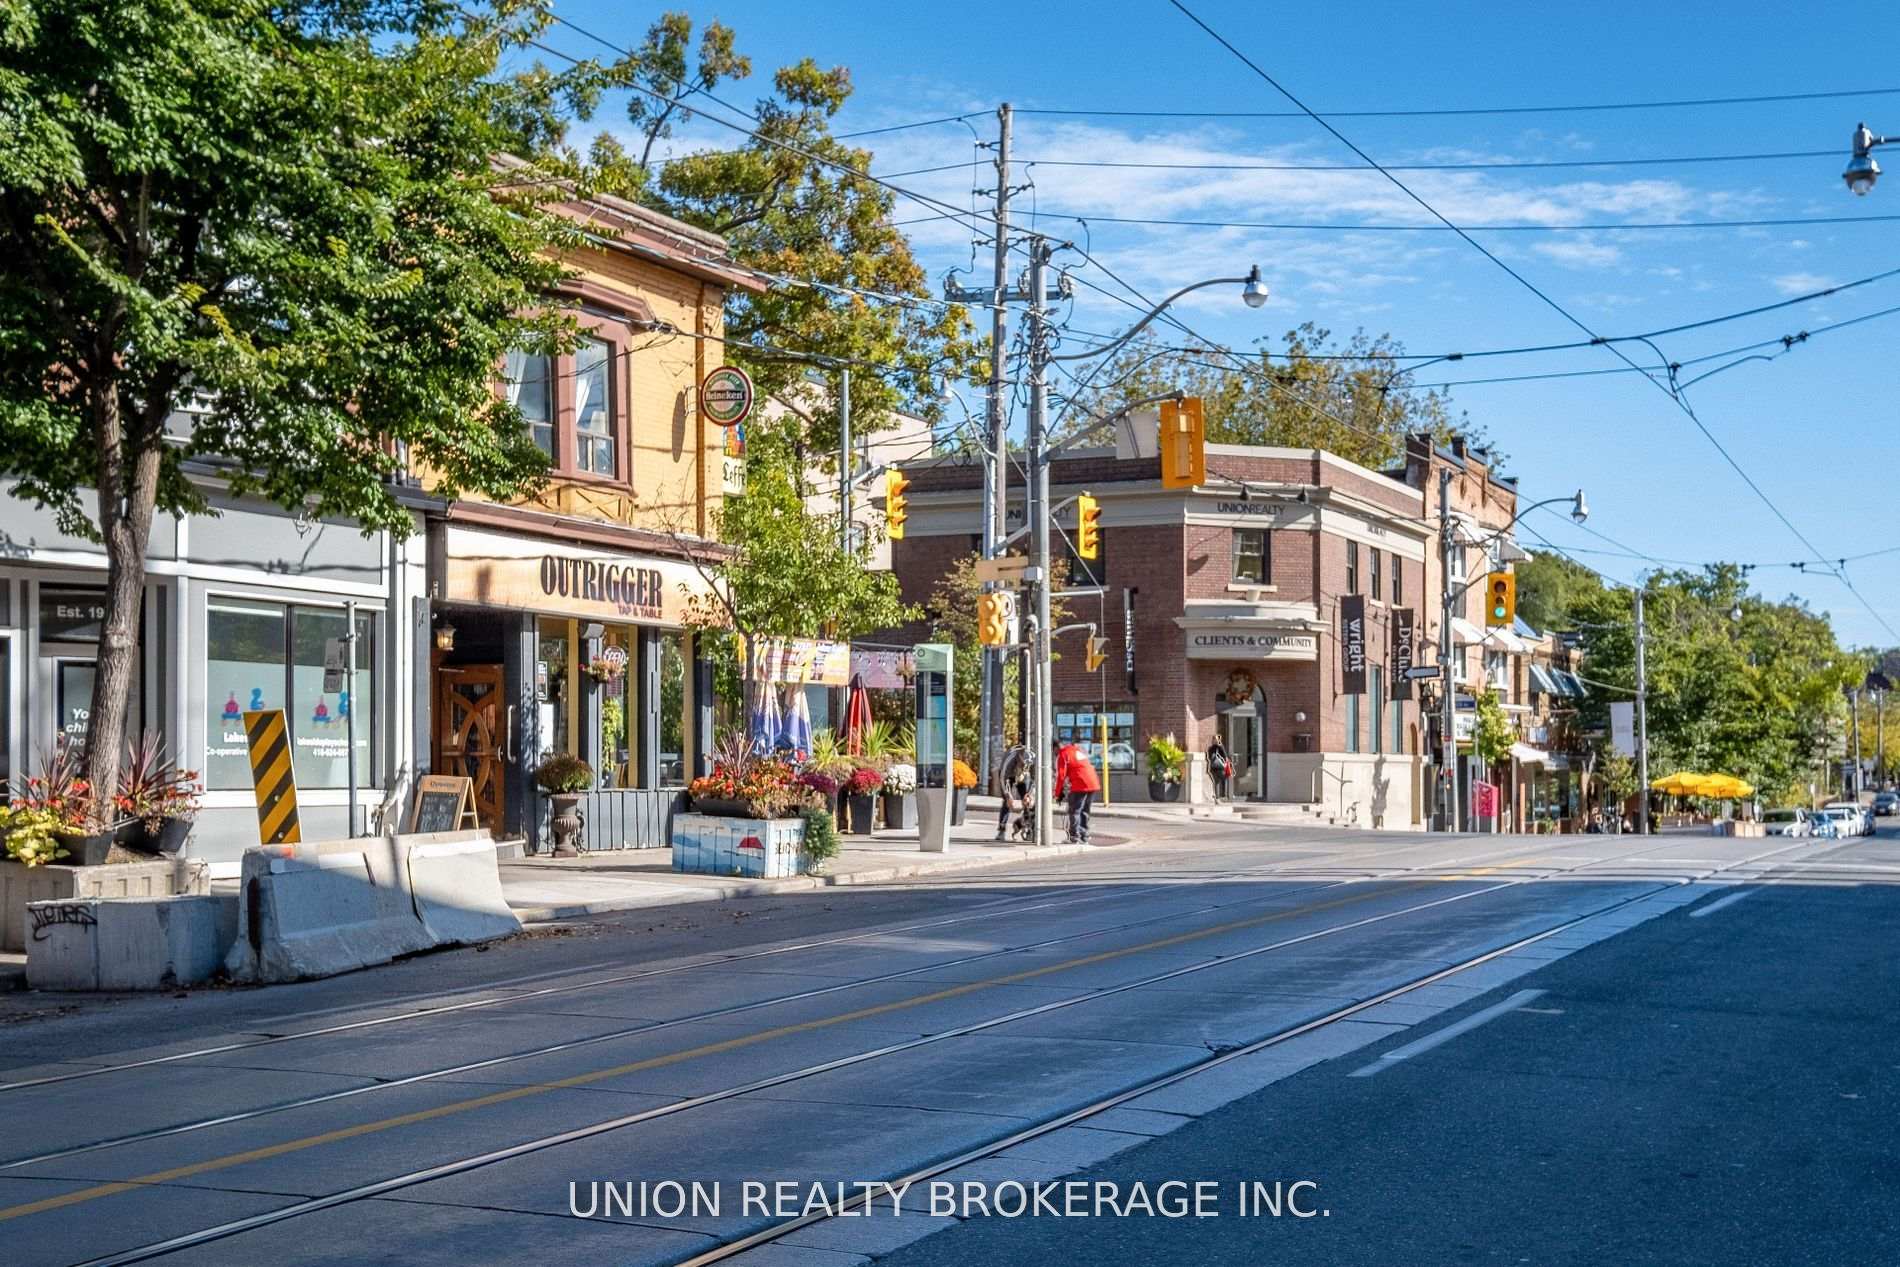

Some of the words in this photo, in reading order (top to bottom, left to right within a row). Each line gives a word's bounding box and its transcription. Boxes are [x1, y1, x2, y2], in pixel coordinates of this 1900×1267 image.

[705, 391, 743, 401] Heineken
[723, 461, 746, 488] Leffe
[540, 554, 663, 607] OUTRIGGER
[57, 605, 84, 618] Est.
[618, 605, 632, 616] TAP
[640, 607, 663, 619] TABLE
[1195, 635, 1244, 646] CLIENTS
[1246, 635, 1255, 646] &
[1257, 635, 1312, 647] COMMUNITY
[1349, 618, 1365, 672] wright
[72, 708, 90, 720] Yo
[69, 736, 86, 747] ho
